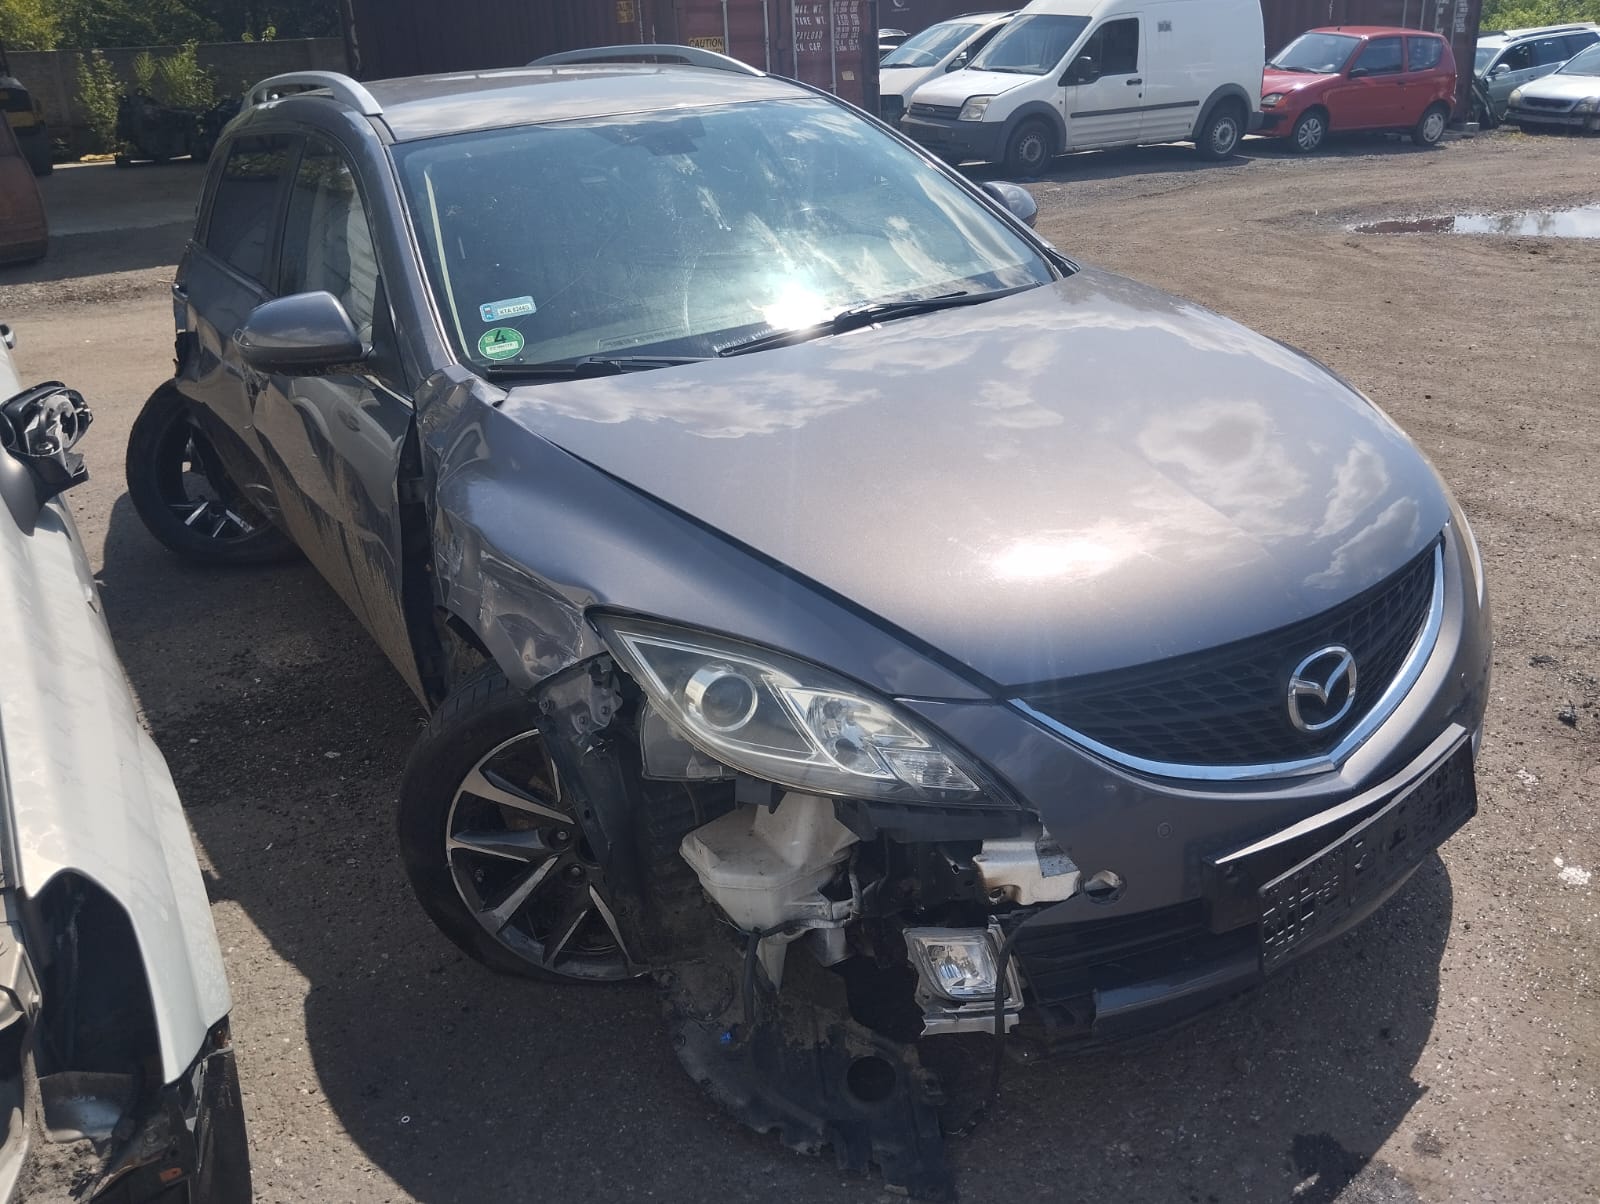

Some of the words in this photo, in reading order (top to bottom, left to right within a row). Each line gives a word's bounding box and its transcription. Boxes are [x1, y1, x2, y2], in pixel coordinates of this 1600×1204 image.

[795, 16, 811, 25] TARE
[796, 30, 823, 40] PAYLOAD
[689, 38, 722, 48] CAUTION
[494, 330, 507, 343] 4
